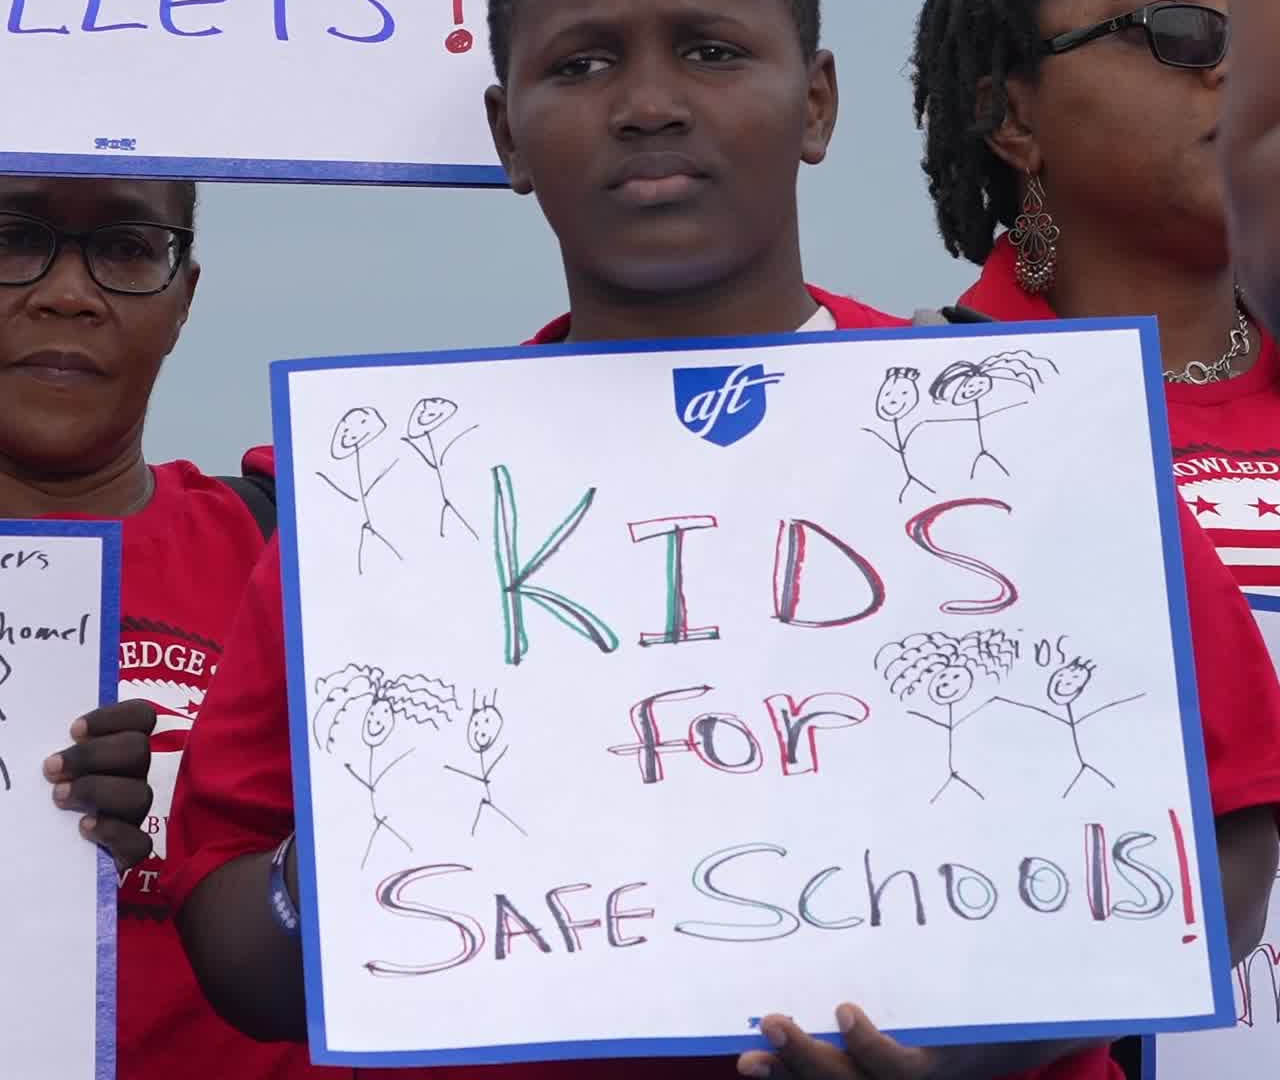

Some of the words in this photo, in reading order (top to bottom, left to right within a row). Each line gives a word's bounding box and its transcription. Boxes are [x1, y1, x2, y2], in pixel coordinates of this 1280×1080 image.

[683, 362, 784, 438] aft
[491, 464, 1020, 666] KIDS
[118, 640, 207, 676] EDGE
[362, 861, 655, 978] SAFE
